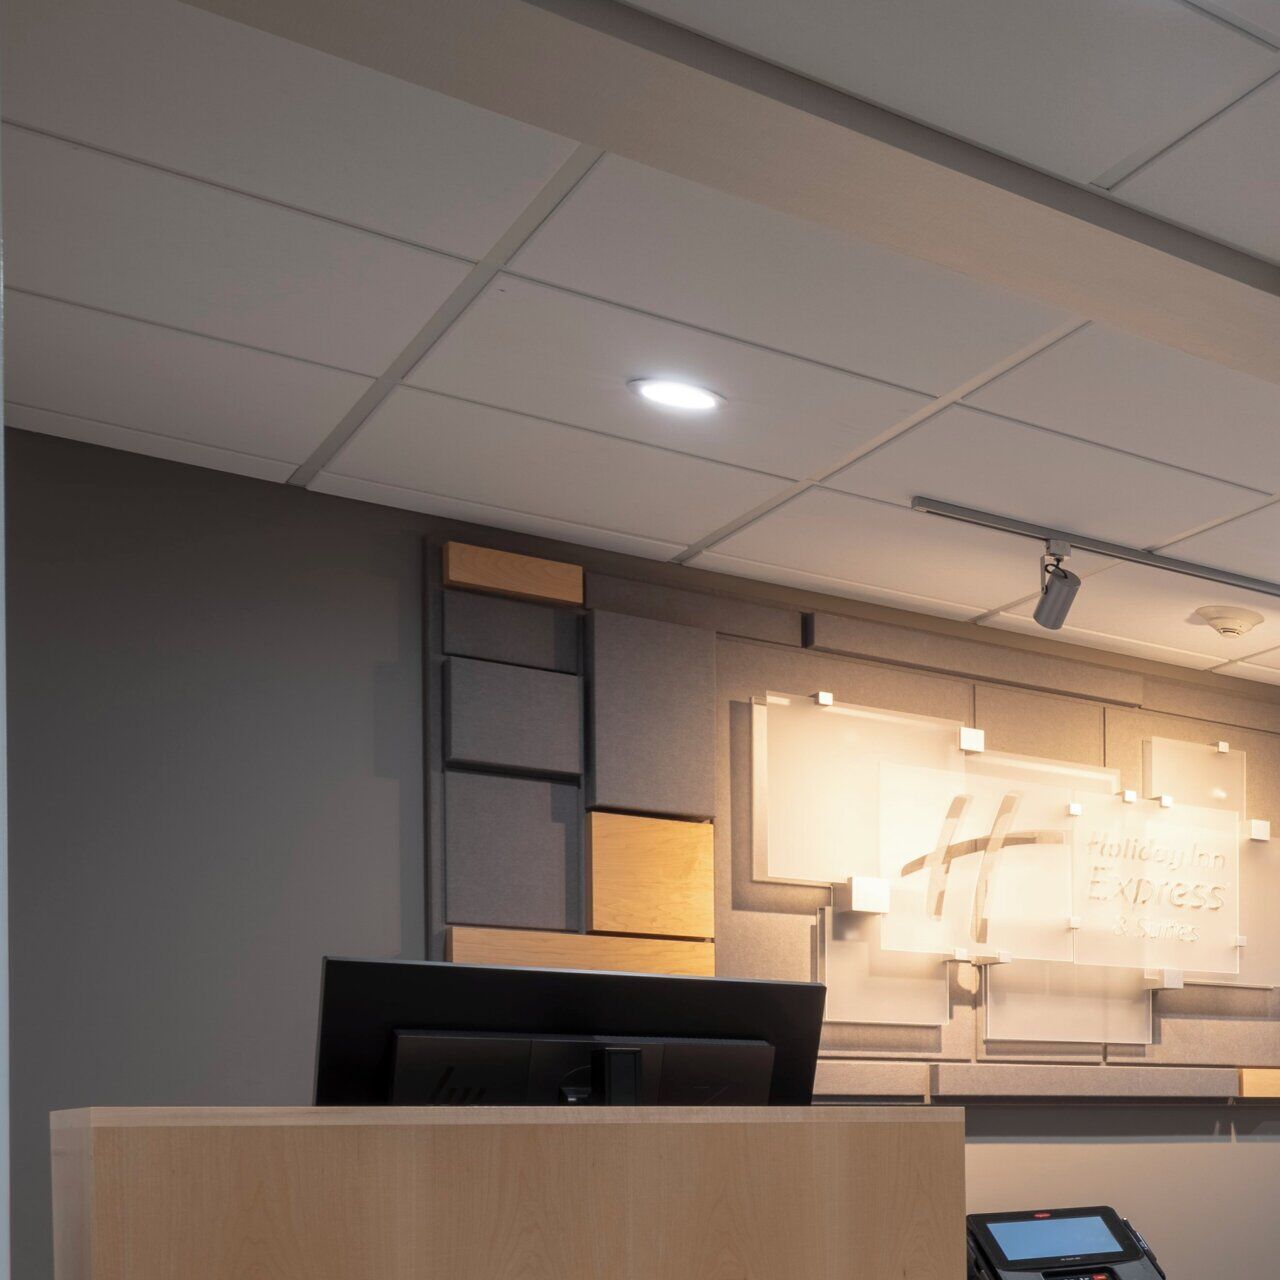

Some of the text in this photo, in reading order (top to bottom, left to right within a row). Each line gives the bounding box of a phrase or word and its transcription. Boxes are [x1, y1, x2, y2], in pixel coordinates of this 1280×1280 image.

[1088, 831, 1227, 871] Holiday Inn
[1088, 865, 1227, 912] Express
[1112, 914, 1201, 943] & Suites
